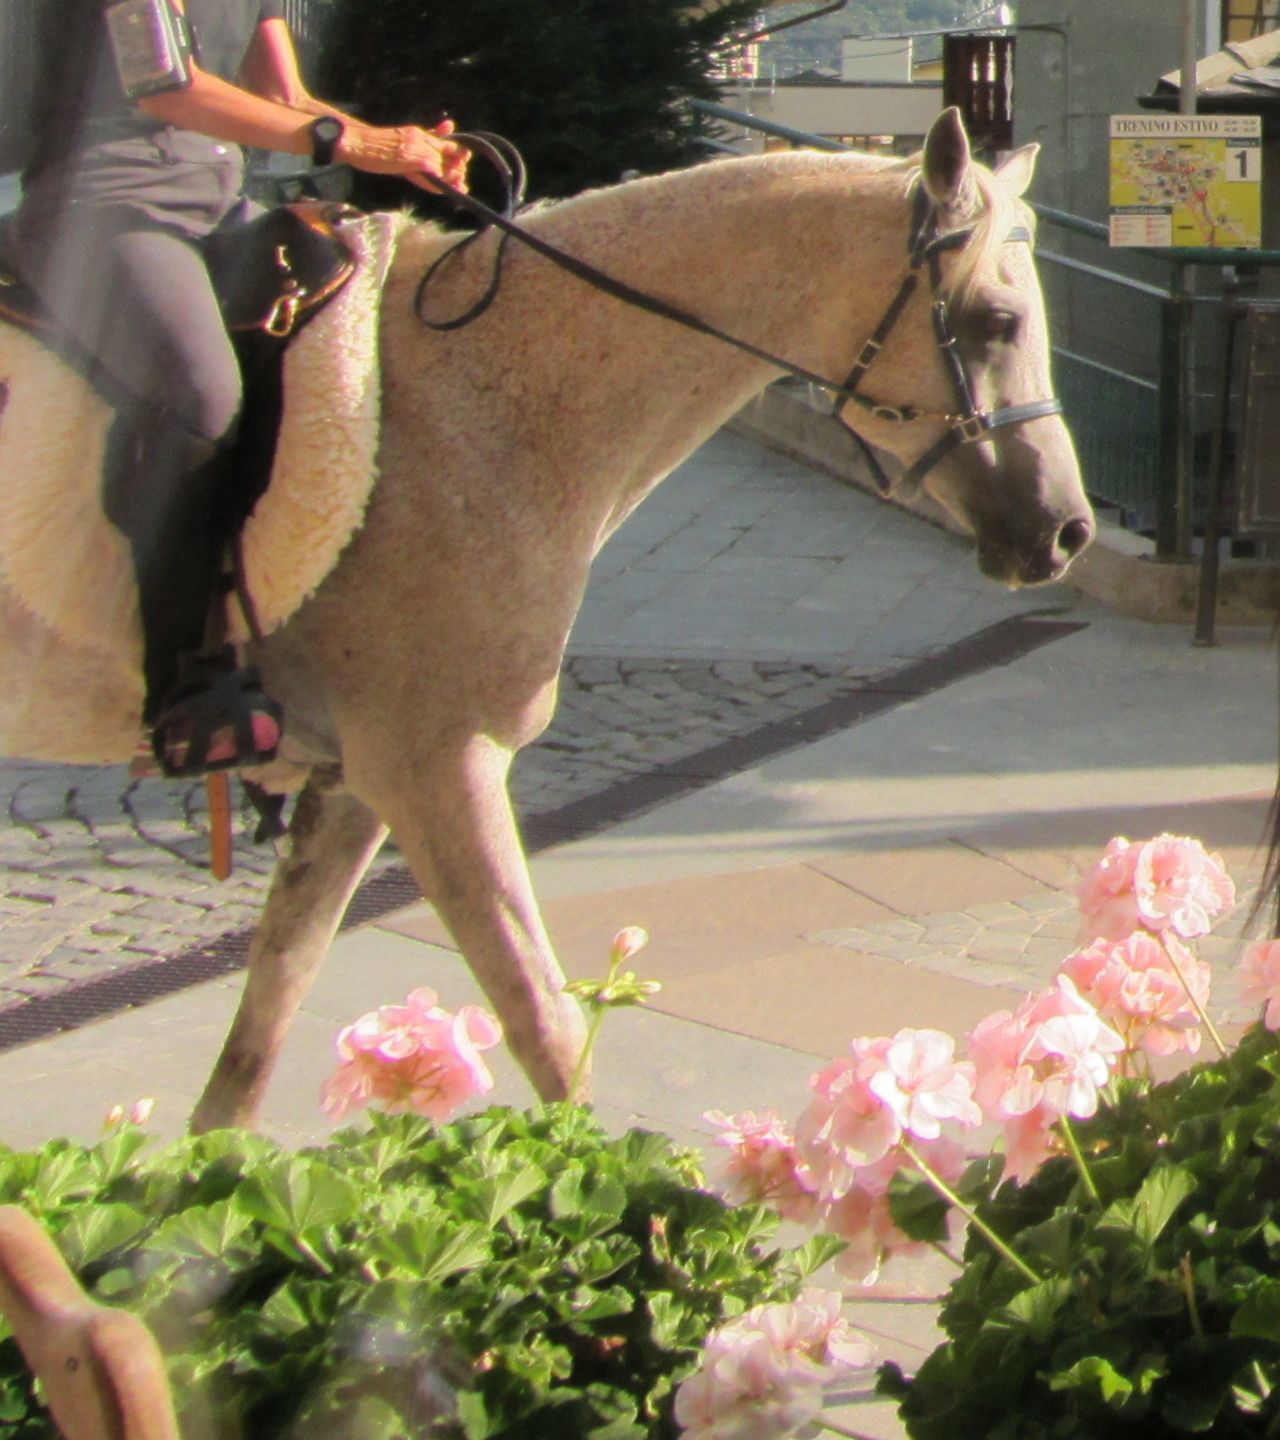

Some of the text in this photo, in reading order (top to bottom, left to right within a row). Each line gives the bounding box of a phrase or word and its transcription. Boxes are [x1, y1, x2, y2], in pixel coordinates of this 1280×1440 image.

[1116, 120, 1170, 132] TRENINO
[1174, 120, 1218, 132] ESTIVO
[1234, 150, 1247, 178] 1
